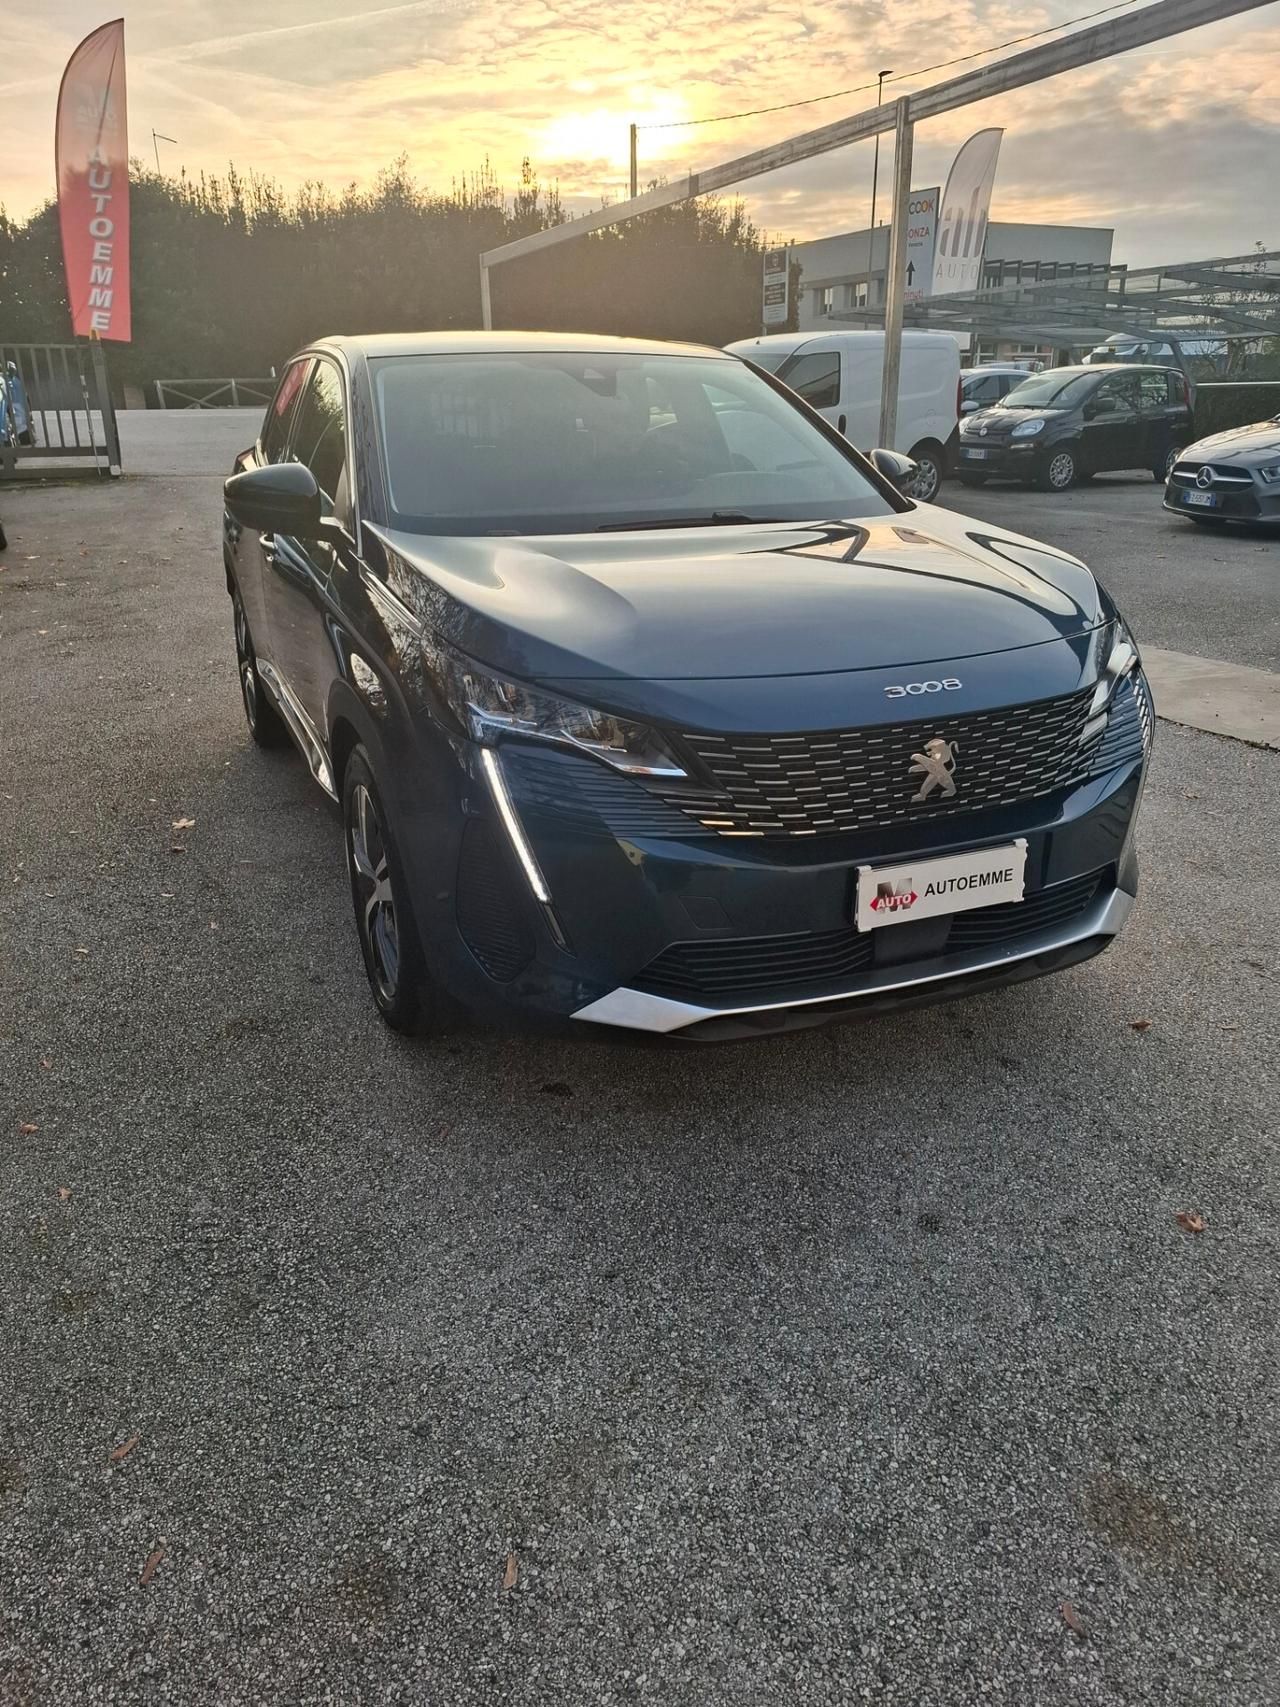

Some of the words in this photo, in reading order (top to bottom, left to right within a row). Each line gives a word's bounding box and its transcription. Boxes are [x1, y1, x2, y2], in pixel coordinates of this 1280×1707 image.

[88, 143, 113, 331] AUTOEMME
[936, 264, 979, 280] AUTO
[883, 678, 963, 699] 3008
[924, 868, 1014, 898] AUTOEMME
[877, 893, 912, 909] AUTO
